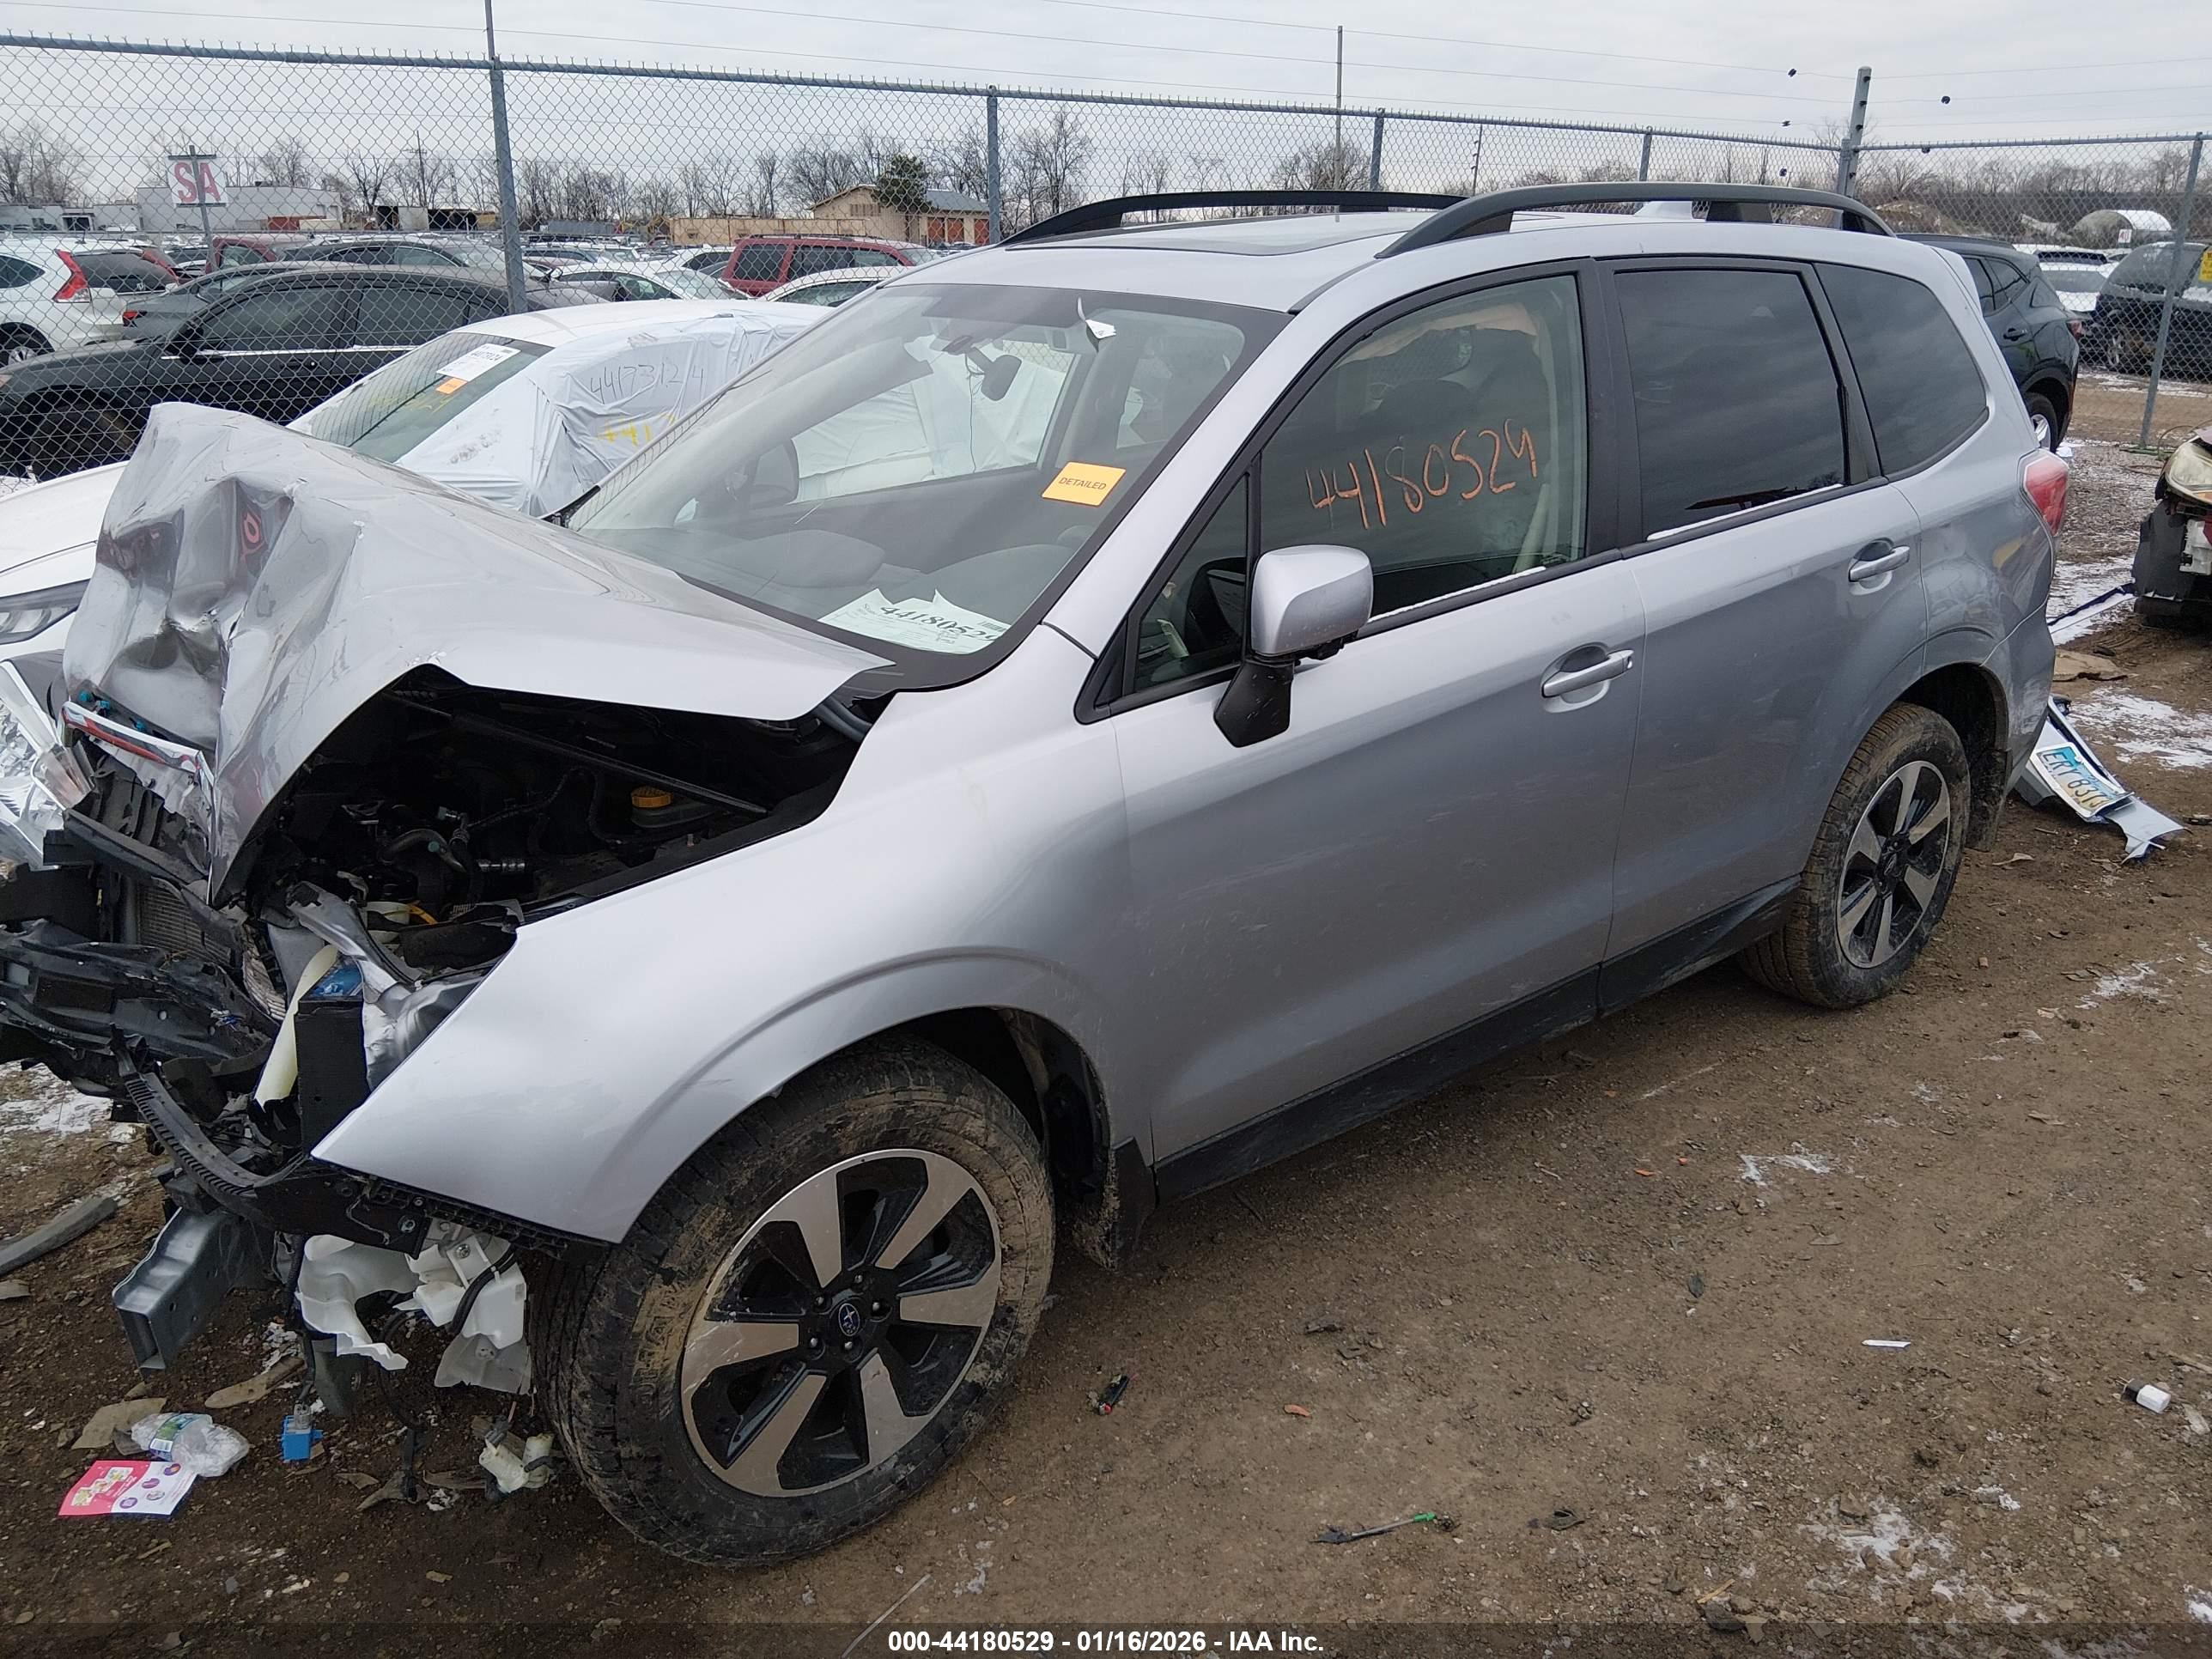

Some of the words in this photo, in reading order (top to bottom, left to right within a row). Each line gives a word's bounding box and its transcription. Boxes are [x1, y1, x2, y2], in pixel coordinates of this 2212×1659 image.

[174, 161, 222, 203] SA
[590, 361, 706, 404] 44173124
[1058, 477, 1107, 490] DETAILED
[2043, 751, 2082, 776] ERY
